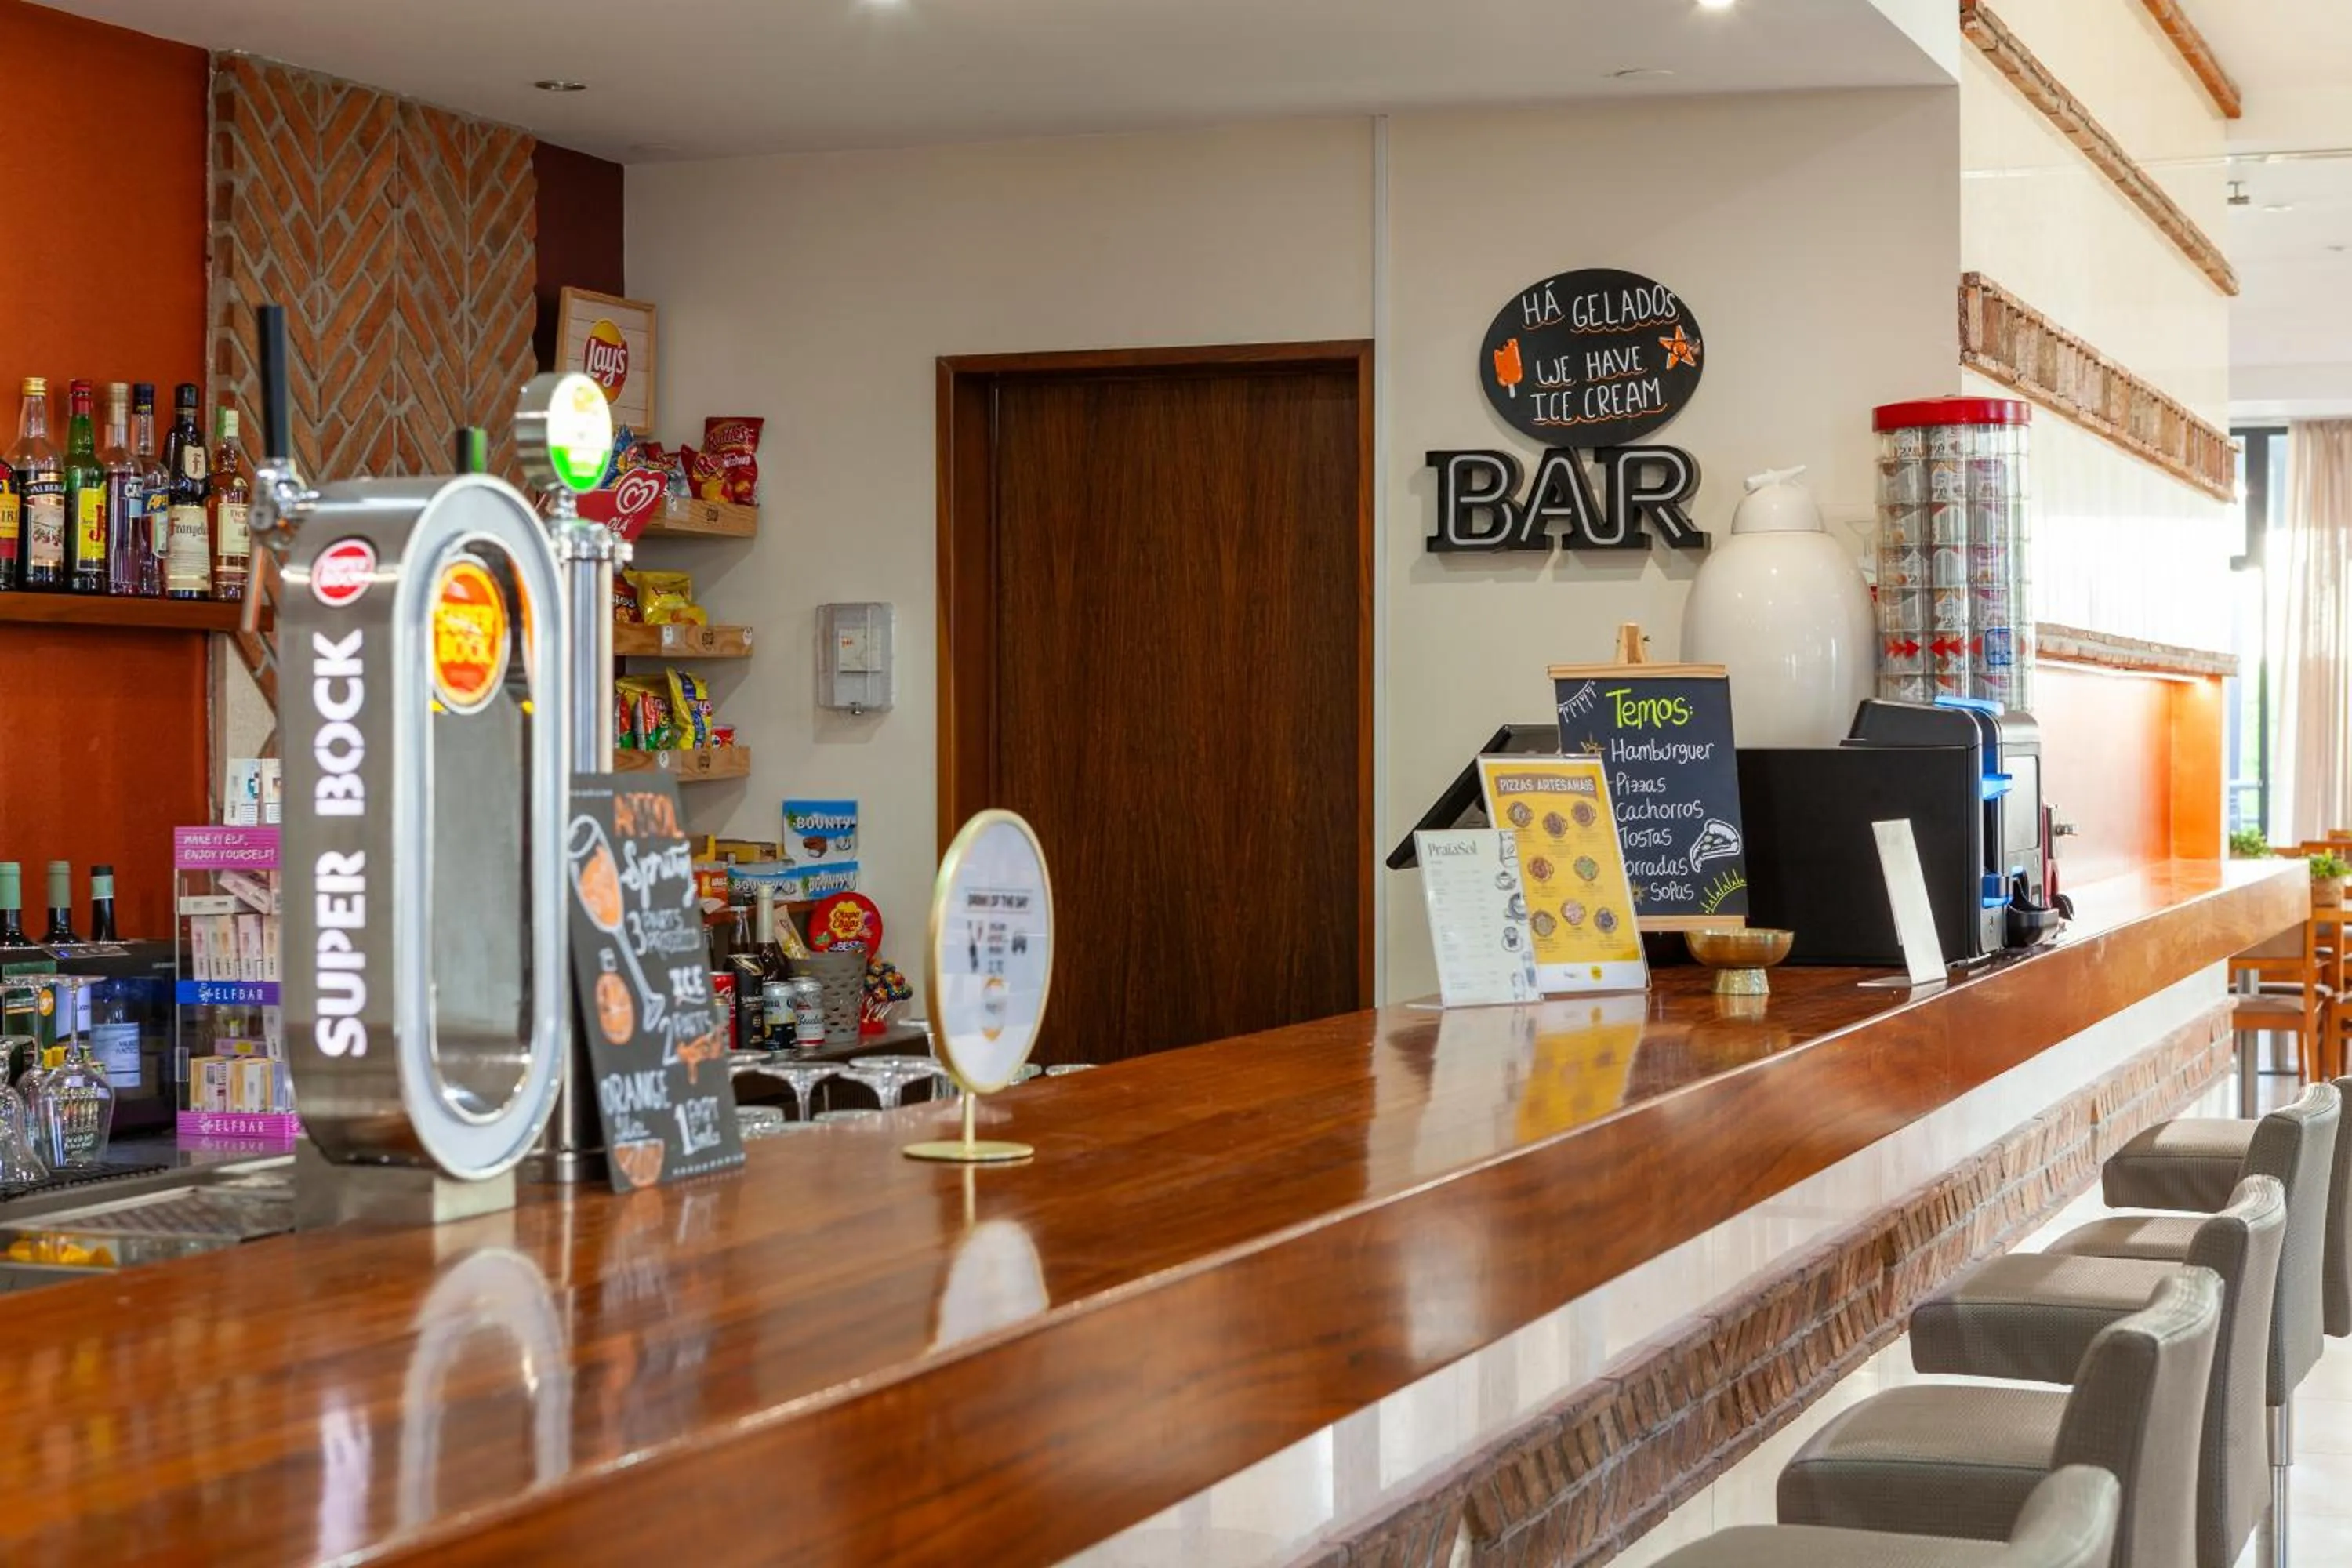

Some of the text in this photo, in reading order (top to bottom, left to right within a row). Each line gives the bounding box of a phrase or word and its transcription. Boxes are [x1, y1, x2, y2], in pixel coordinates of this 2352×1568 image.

[1521, 280, 1678, 328] HÁ GELADOS
[586, 337, 627, 388] Lay's
[1535, 346, 1643, 385] WE HAVE
[1530, 377, 1661, 422] ICE CREAM
[1425, 445, 1711, 553] BAR
[313, 628, 365, 816] BOCK
[1610, 737, 1715, 764] Hamburguer
[1499, 776, 1595, 792] PIZZAS ARTESANAIS
[1615, 771, 1667, 797] Pizzas
[795, 812, 849, 829] BOUNTY
[1615, 797, 1704, 822] Cachorros
[1620, 854, 1688, 876] orradas
[315, 850, 368, 1058] SUPER
